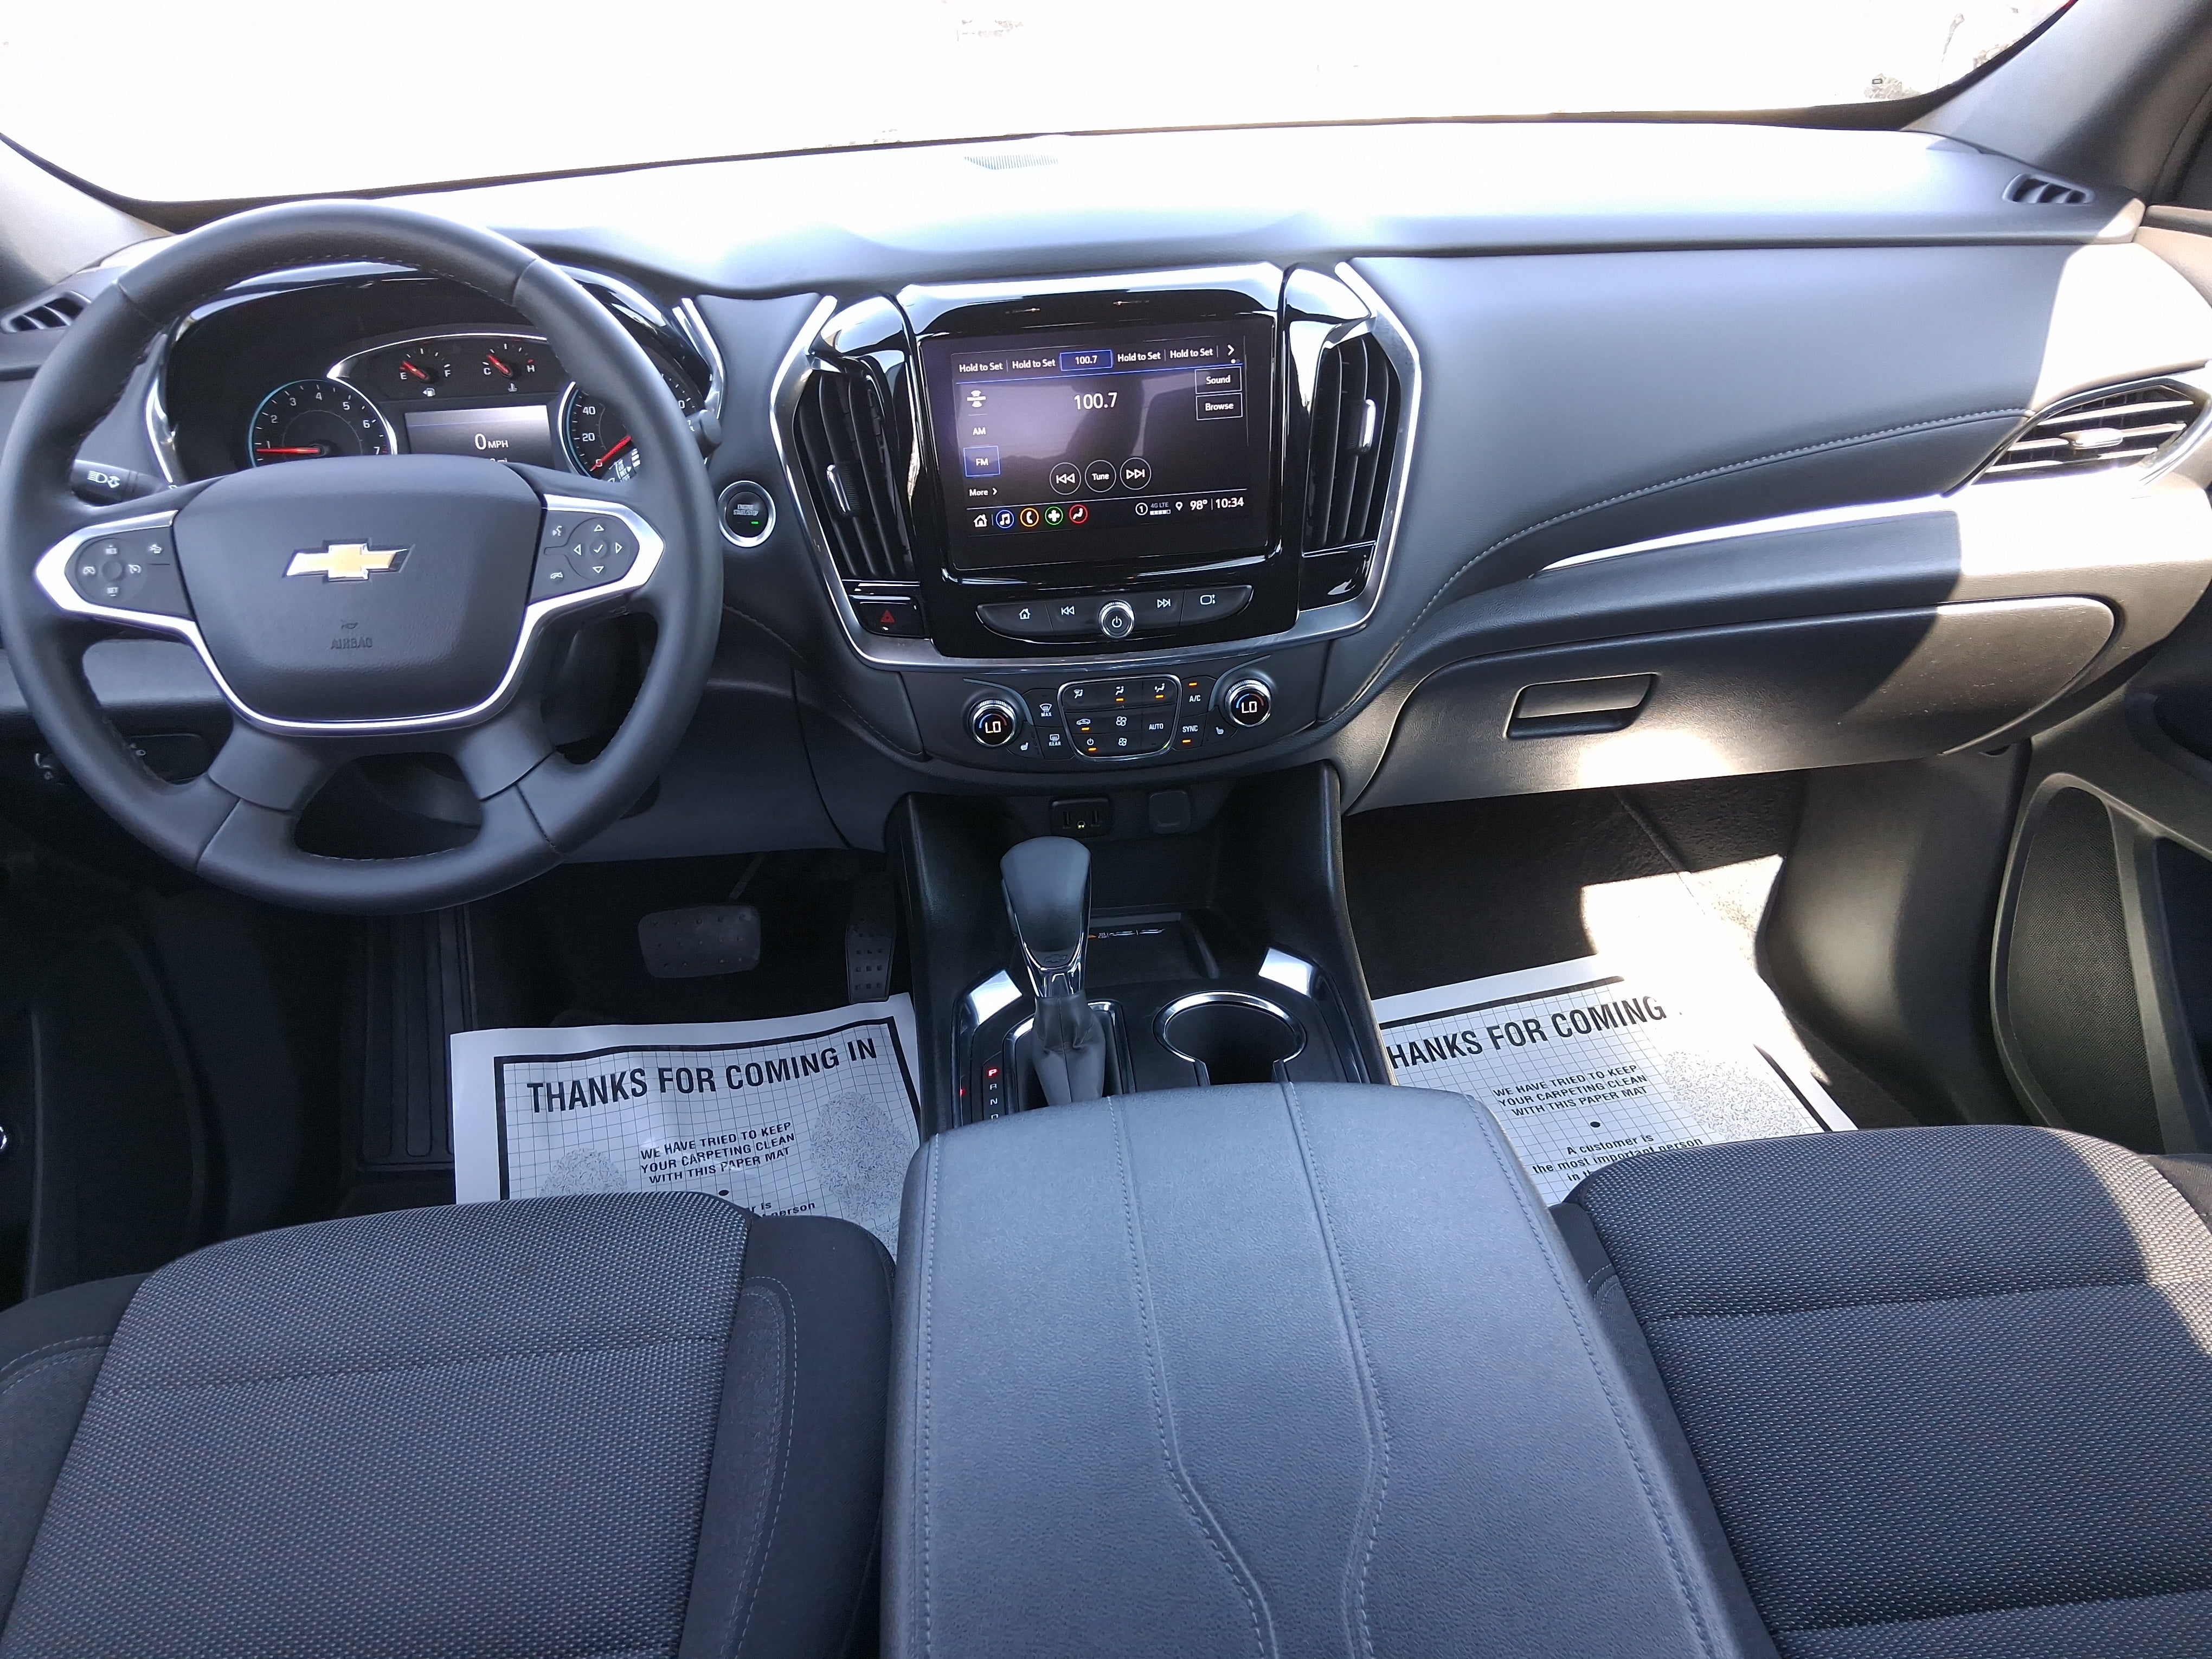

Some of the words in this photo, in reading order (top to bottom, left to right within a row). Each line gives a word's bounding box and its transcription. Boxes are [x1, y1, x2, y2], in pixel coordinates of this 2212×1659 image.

[1117, 353, 1136, 362] Hold
[1147, 351, 1161, 361] Set
[1170, 349, 1189, 358] Hold
[1200, 348, 1213, 356] Set
[1012, 359, 1031, 369] Hold
[1032, 360, 1041, 368] to
[1042, 358, 1056, 367] Set
[1075, 355, 1098, 365] 100.7
[959, 363, 978, 372] Hold
[989, 362, 1003, 371] Set
[400, 372, 407, 380] E
[445, 369, 451, 377] F
[1205, 374, 1231, 385] Sound
[290, 397, 297, 406] 3
[316, 392, 322, 401] 4
[1074, 392, 1117, 410] 100.7
[343, 401, 350, 410] 5
[582, 406, 596, 415] 40
[1205, 402, 1234, 411] Browse
[271, 415, 278, 423] 2
[363, 420, 370, 428] 6
[973, 427, 986, 435] AM
[582, 433, 595, 441] 20
[488, 440, 509, 449] MPH
[374, 446, 381, 455] 7
[976, 458, 988, 466] FM
[1091, 472, 1110, 481] Tune
[1216, 497, 1244, 509] 10:34
[1386, 1030, 1483, 1069] HANKS
[1487, 1018, 1548, 1050] FOR
[1552, 995, 1667, 1038] COMING
[526, 1068, 648, 1113] THANKS
[658, 1066, 716, 1094] FOR
[725, 1047, 839, 1090] COMING
[847, 1038, 878, 1062] IN
[1493, 1087, 1515, 1097] WE
[1515, 1082, 1548, 1093] HAVE
[1549, 1075, 1586, 1088] TRIED
[1587, 1070, 1605, 1079] TO
[1607, 1065, 1637, 1077] KEEP
[1498, 1095, 1534, 1107] YOUR
[1536, 1083, 1605, 1102] CARPETING
[1607, 1075, 1648, 1088] CLEAN
[1511, 1104, 1545, 1116] WITH
[1546, 1099, 1577, 1110] THIS
[1578, 1092, 1619, 1105] PAPER
[1621, 1085, 1648, 1098] MAT
[641, 1146, 660, 1160] WE
[664, 1140, 696, 1155] HAVE
[699, 1133, 737, 1147] TRIED
[741, 1130, 757, 1140] TO
[761, 1122, 792, 1137] KEEP
[1567, 1147, 1577, 1155] A
[1579, 1136, 1638, 1153] customer
[1640, 1134, 1655, 1142] is
[641, 1159, 677, 1173] YOUR
[681, 1144, 751, 1166] CARPETING
[756, 1133, 795, 1151] CLEAN
[649, 1171, 683, 1184] WITH
[687, 1165, 716, 1178] THIS
[721, 1155, 761, 1172] PAPER
[765, 1147, 790, 1162] MAT
[1533, 1163, 1554, 1174] the
[1557, 1157, 1591, 1170] most
[1567, 1173, 1581, 1181] in
